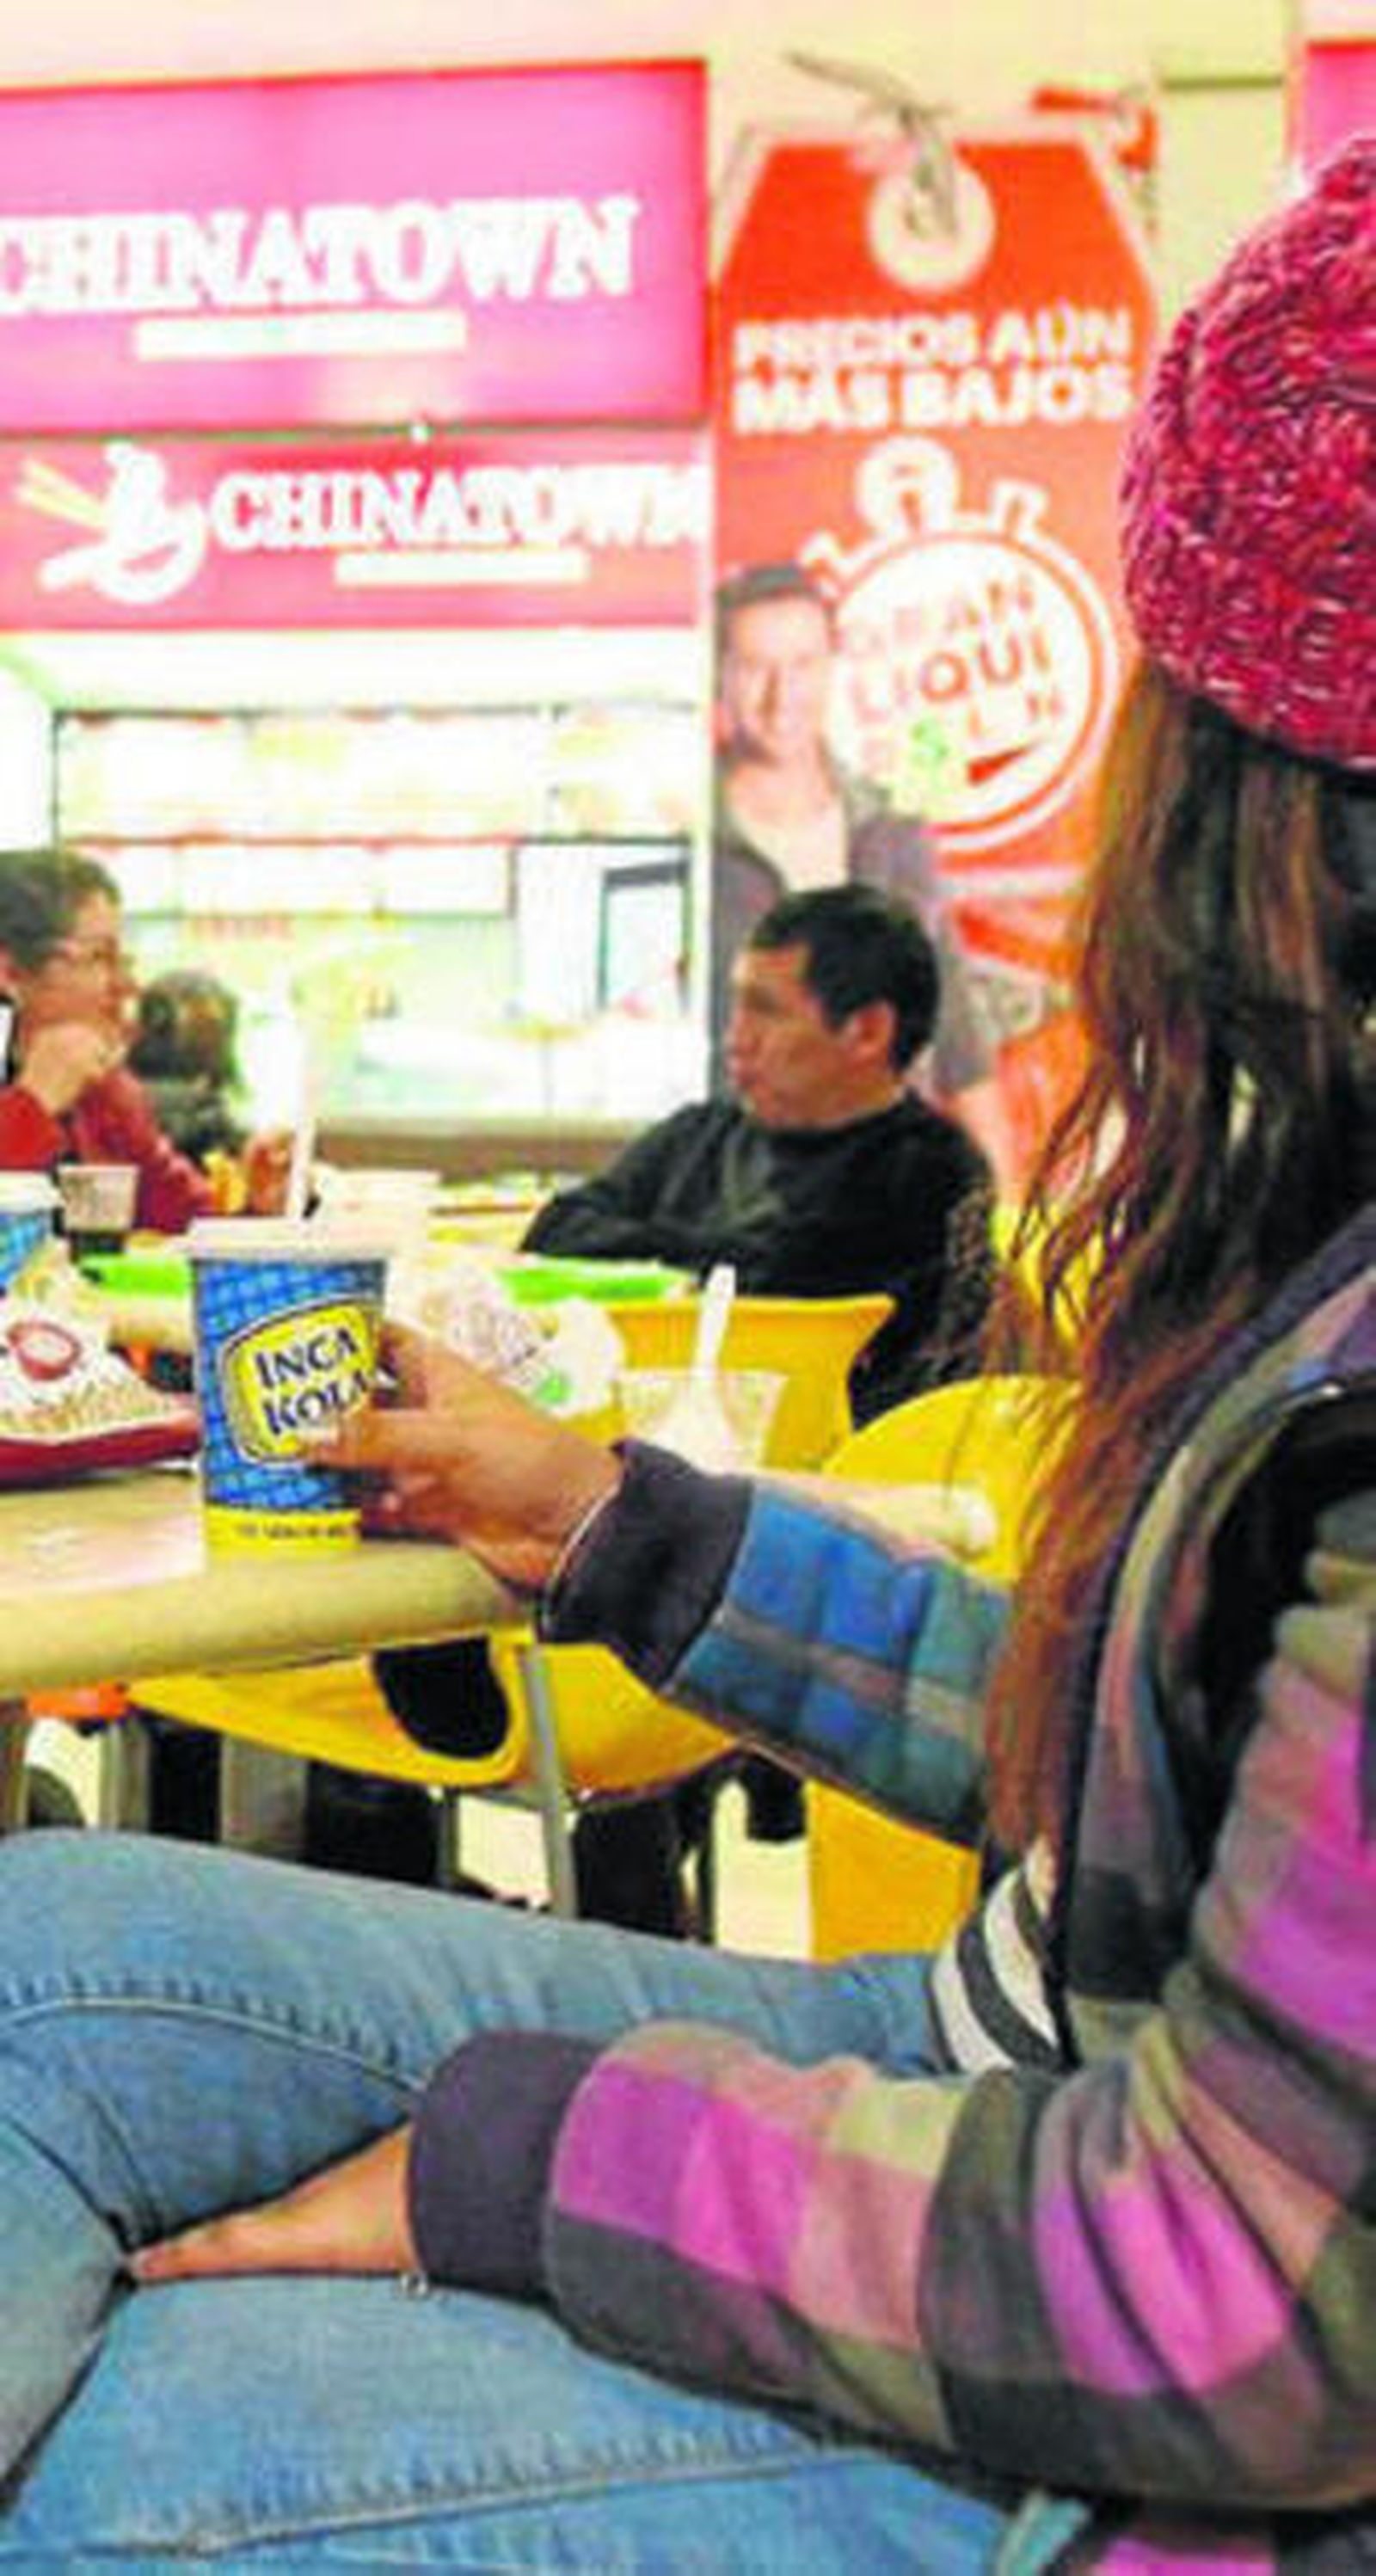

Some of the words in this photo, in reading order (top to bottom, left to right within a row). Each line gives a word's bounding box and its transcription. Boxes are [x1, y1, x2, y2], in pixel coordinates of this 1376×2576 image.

[0, 196, 639, 316] CHINATOWN
[733, 315, 979, 372] PRECIOS
[900, 363, 1133, 430] BAJOS
[209, 464, 710, 550] CHINATOWN
[254, 1327, 358, 1388] INCA
